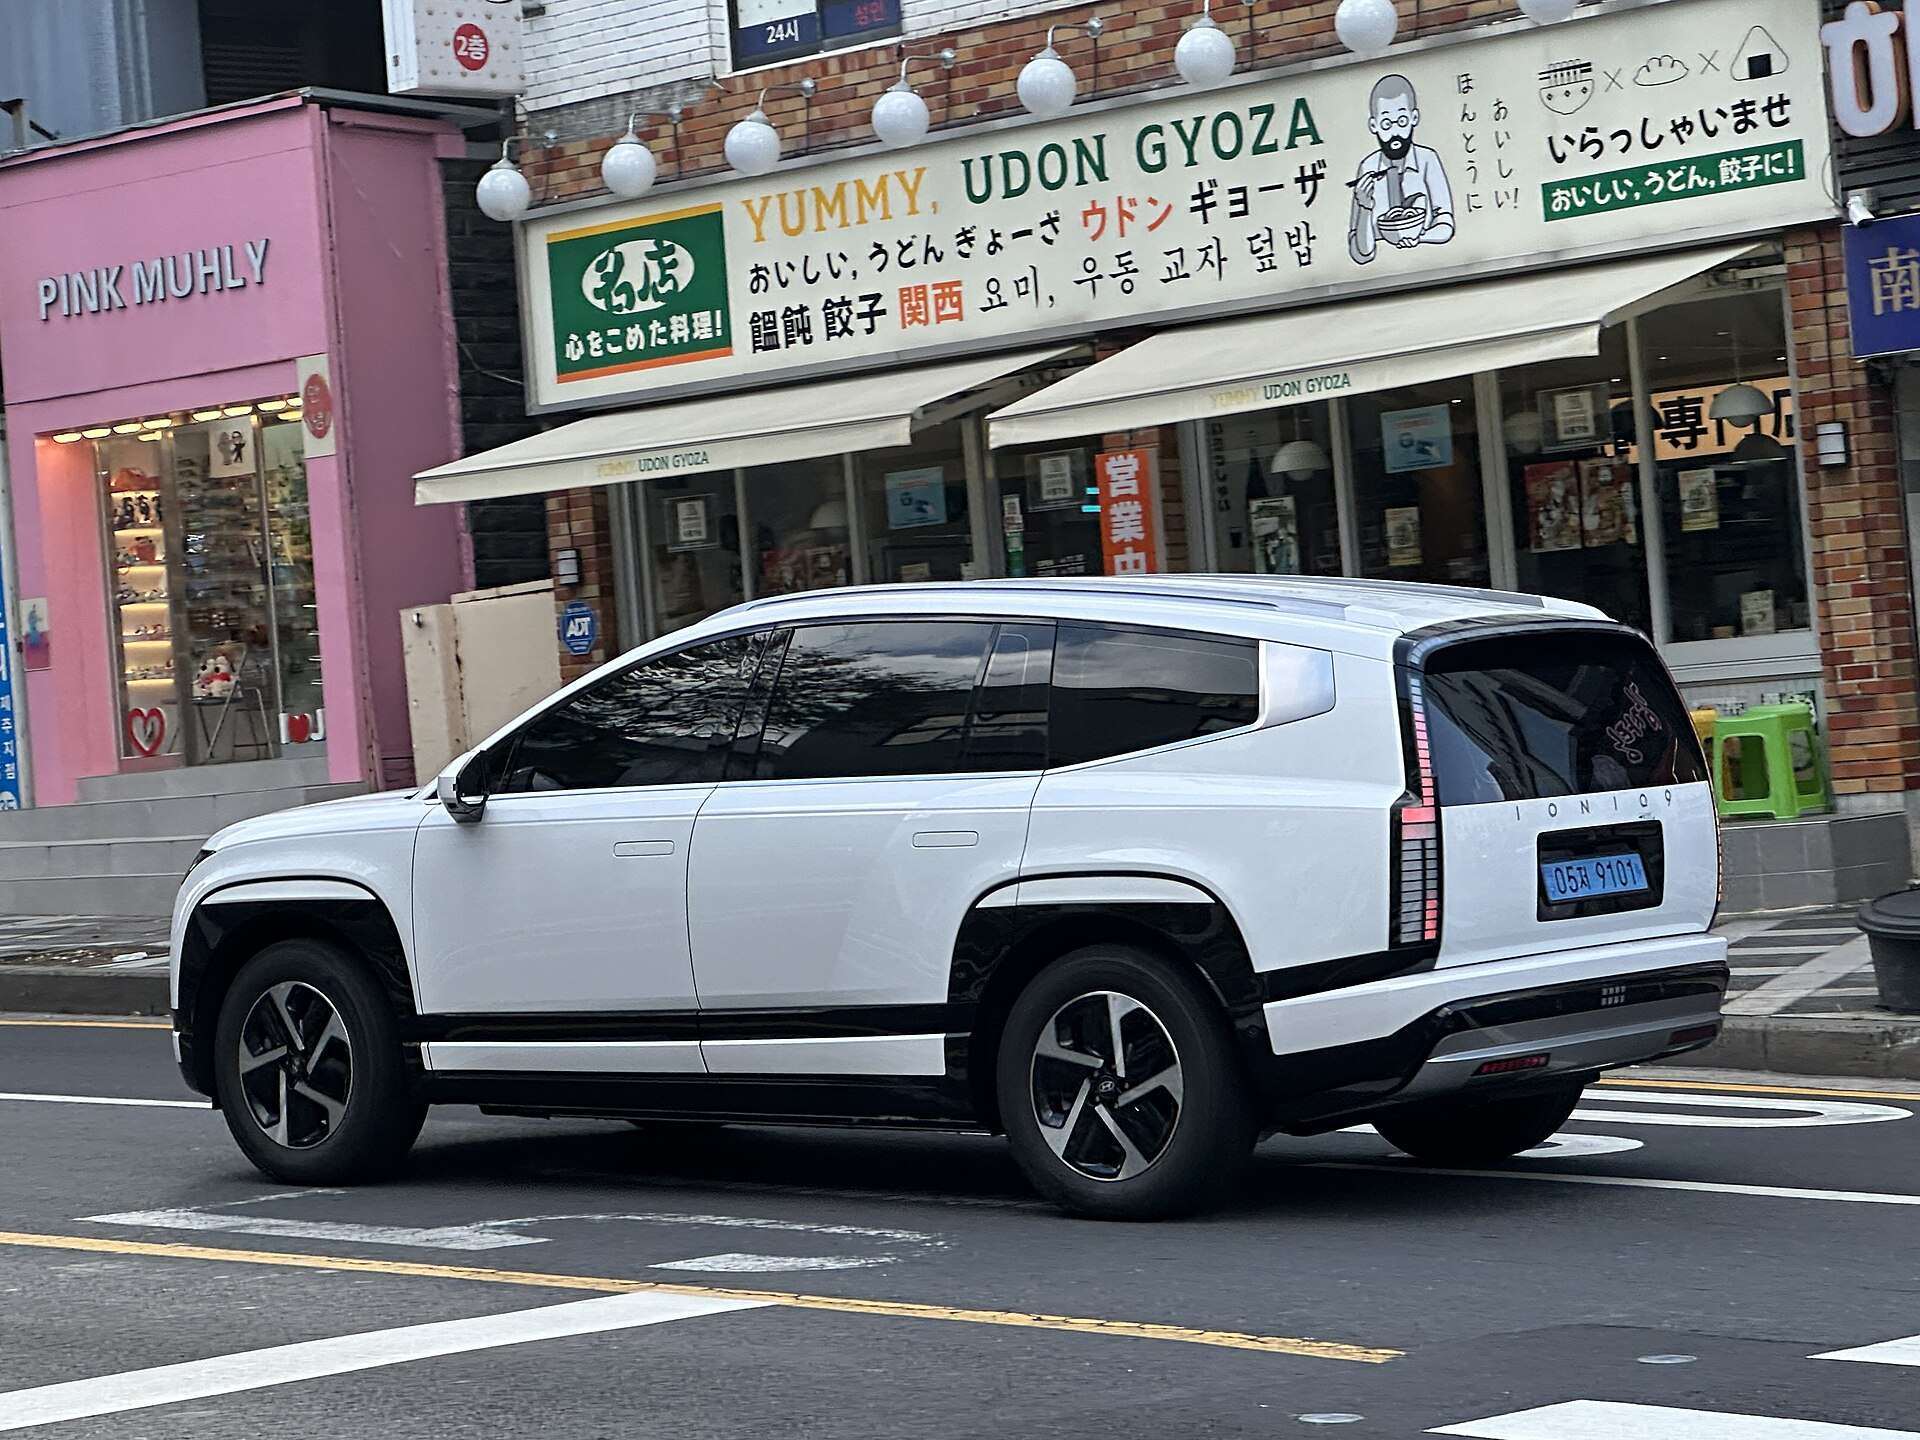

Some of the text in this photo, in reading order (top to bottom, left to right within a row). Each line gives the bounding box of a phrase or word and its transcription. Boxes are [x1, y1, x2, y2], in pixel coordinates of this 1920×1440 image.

[455, 35, 487, 61] 2층
[766, 19, 799, 44] 24시
[1456, 72, 1483, 214] ほんとうに
[1493, 98, 1521, 211] おいしい!
[1547, 92, 1791, 165] いらっしゃいませ
[740, 96, 1324, 243] YUMMY, UDON GYOZA
[1080, 195, 1175, 242] ウドン
[1189, 158, 1328, 225] ギョーザ
[37, 238, 271, 322] PINK MUHLY
[822, 291, 888, 341] 餃子
[897, 279, 966, 330] 関西
[1072, 250, 1141, 300] 우동
[1159, 236, 1229, 286] 교자
[1246, 220, 1318, 274] 덮밥
[564, 309, 723, 362] 心をこめた料理!
[1263, 380, 1302, 400] UDON
[1306, 372, 1352, 393] GYOZA
[637, 455, 670, 472] UDON
[672, 451, 710, 468] GYOZA
[565, 616, 591, 638] ADT
[1594, 858, 1638, 889] 9101
